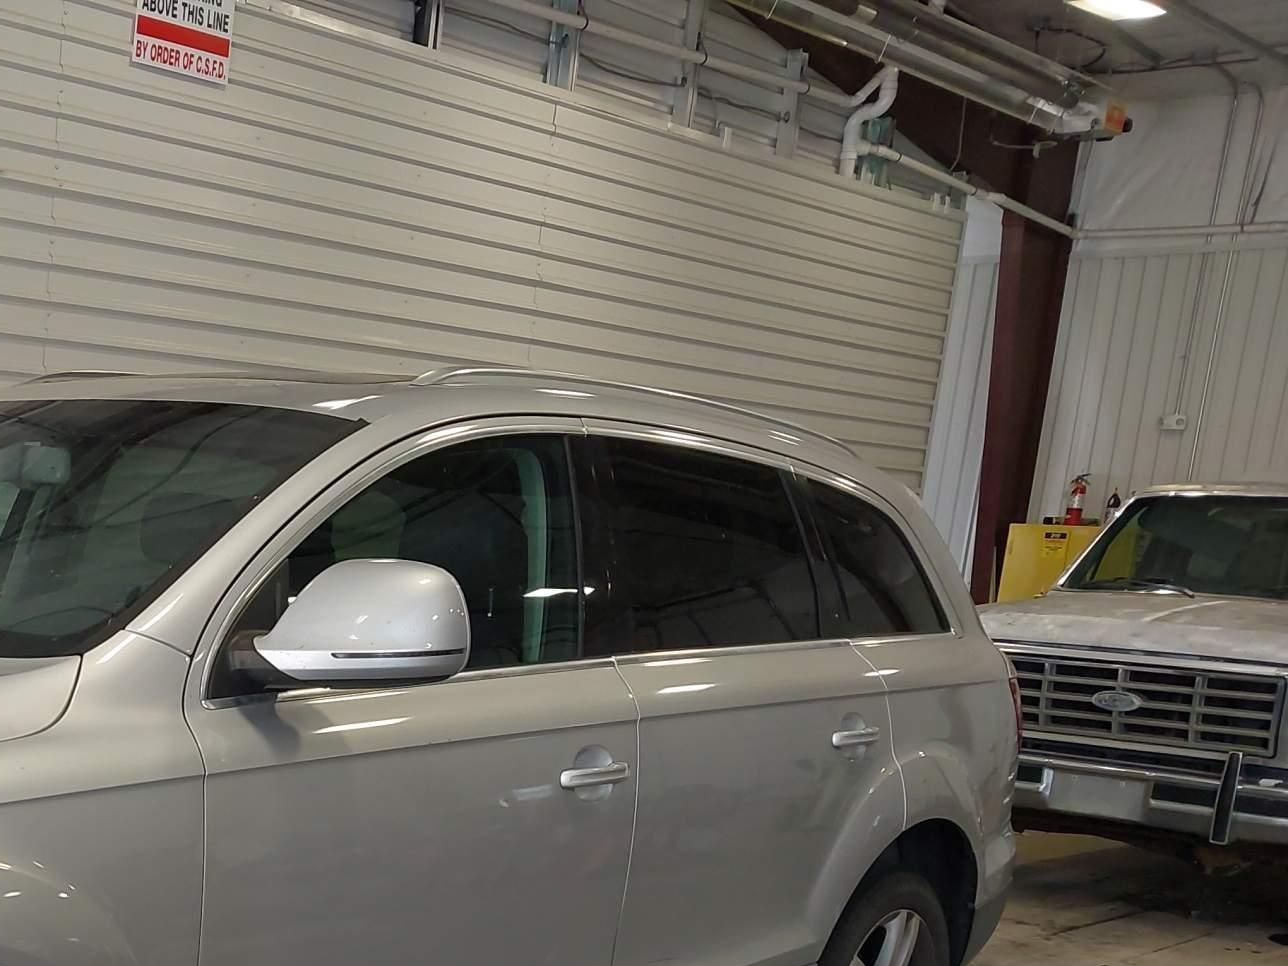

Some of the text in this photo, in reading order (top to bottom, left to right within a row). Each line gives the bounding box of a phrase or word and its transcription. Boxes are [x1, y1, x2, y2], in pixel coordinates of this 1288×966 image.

[142, 0, 230, 33] ABOVE THIS LINE
[135, 40, 226, 80] BY ORDER OF C.S.F.D.
